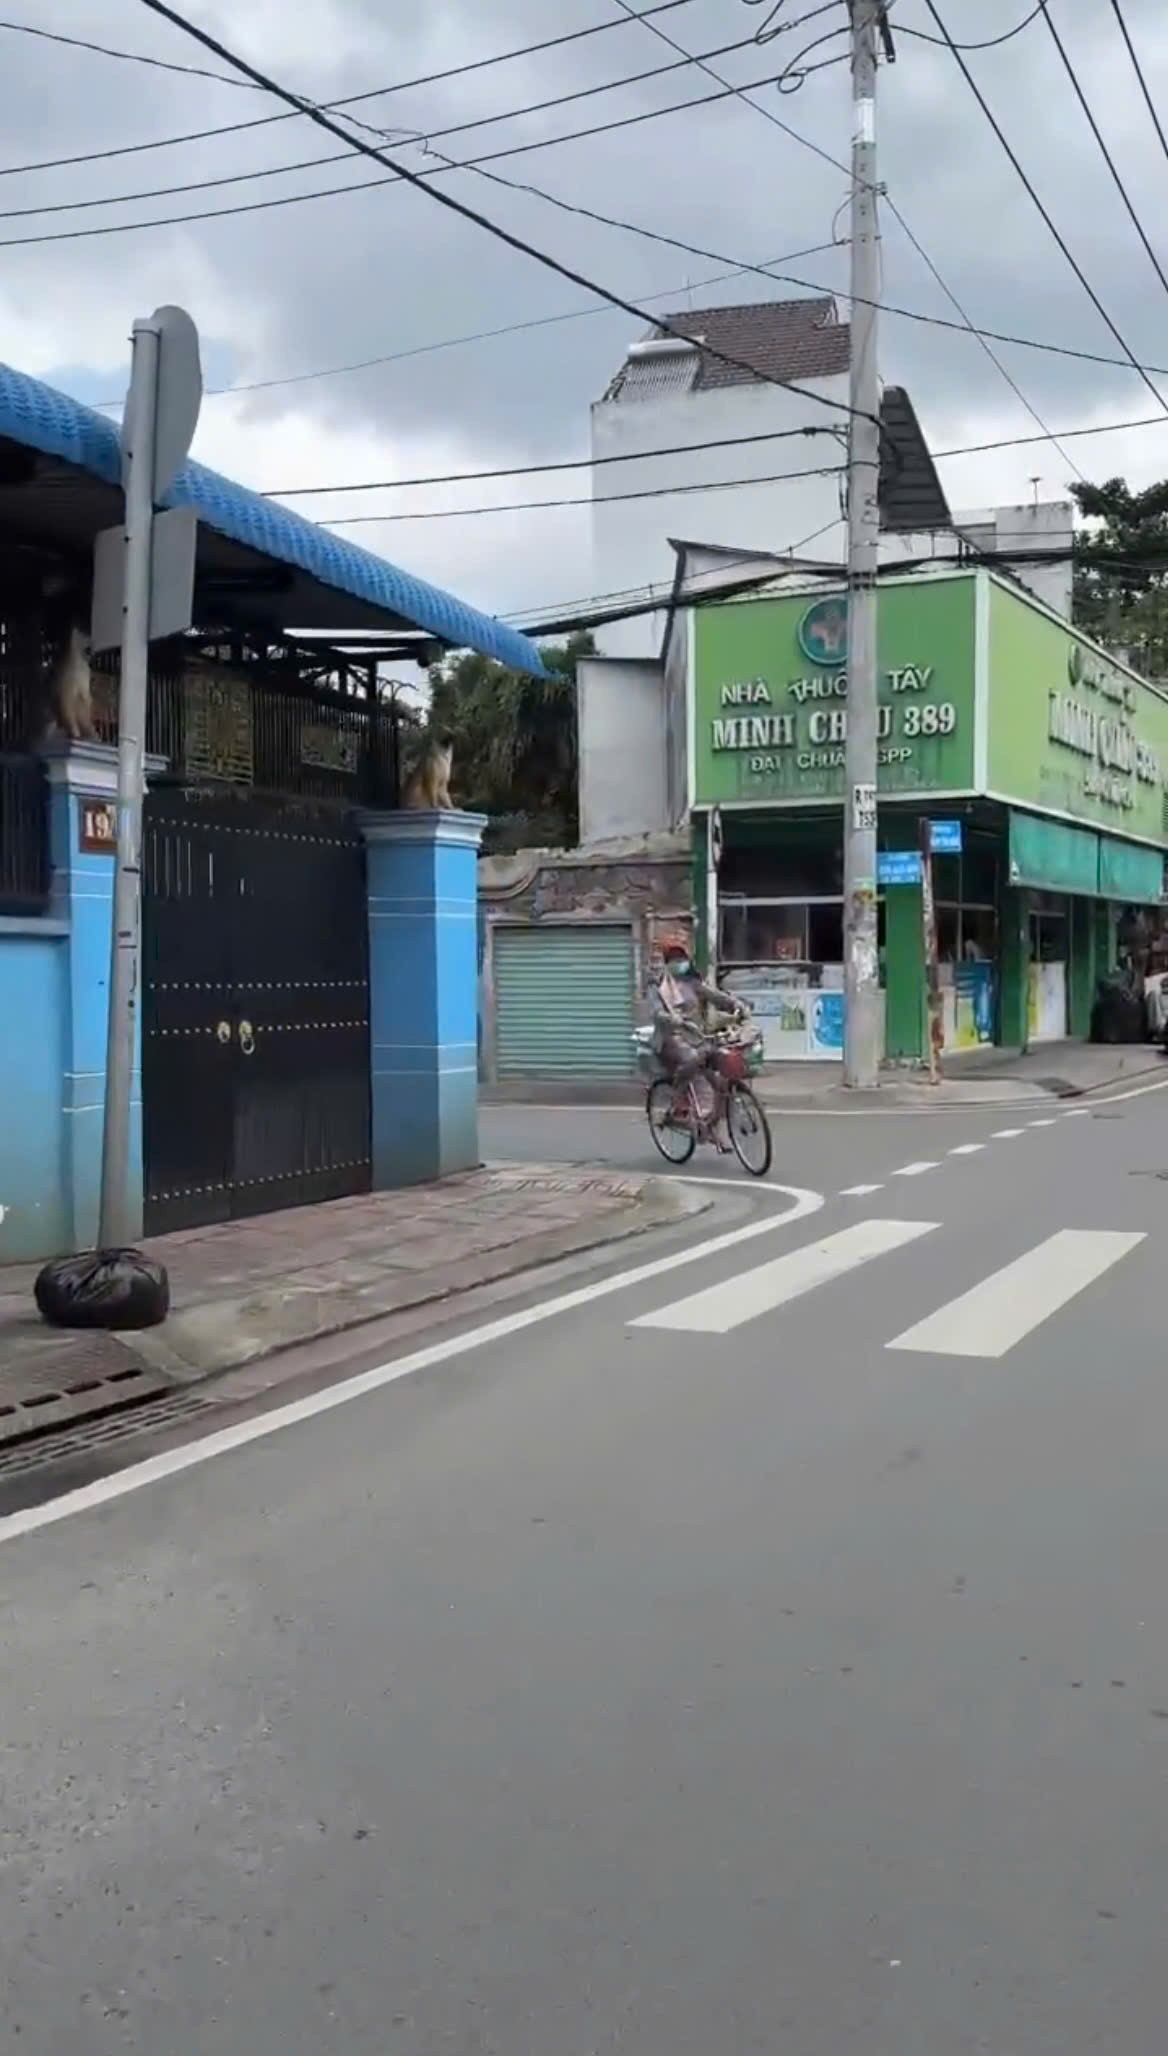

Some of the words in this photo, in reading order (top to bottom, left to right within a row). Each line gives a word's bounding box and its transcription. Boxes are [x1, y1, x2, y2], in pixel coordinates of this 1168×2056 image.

[721, 677, 770, 704] NHÀ
[888, 664, 932, 691] TÂY
[712, 714, 795, 751] MINH
[808, 704, 893, 744] CHU
[904, 702, 956, 737] 389
